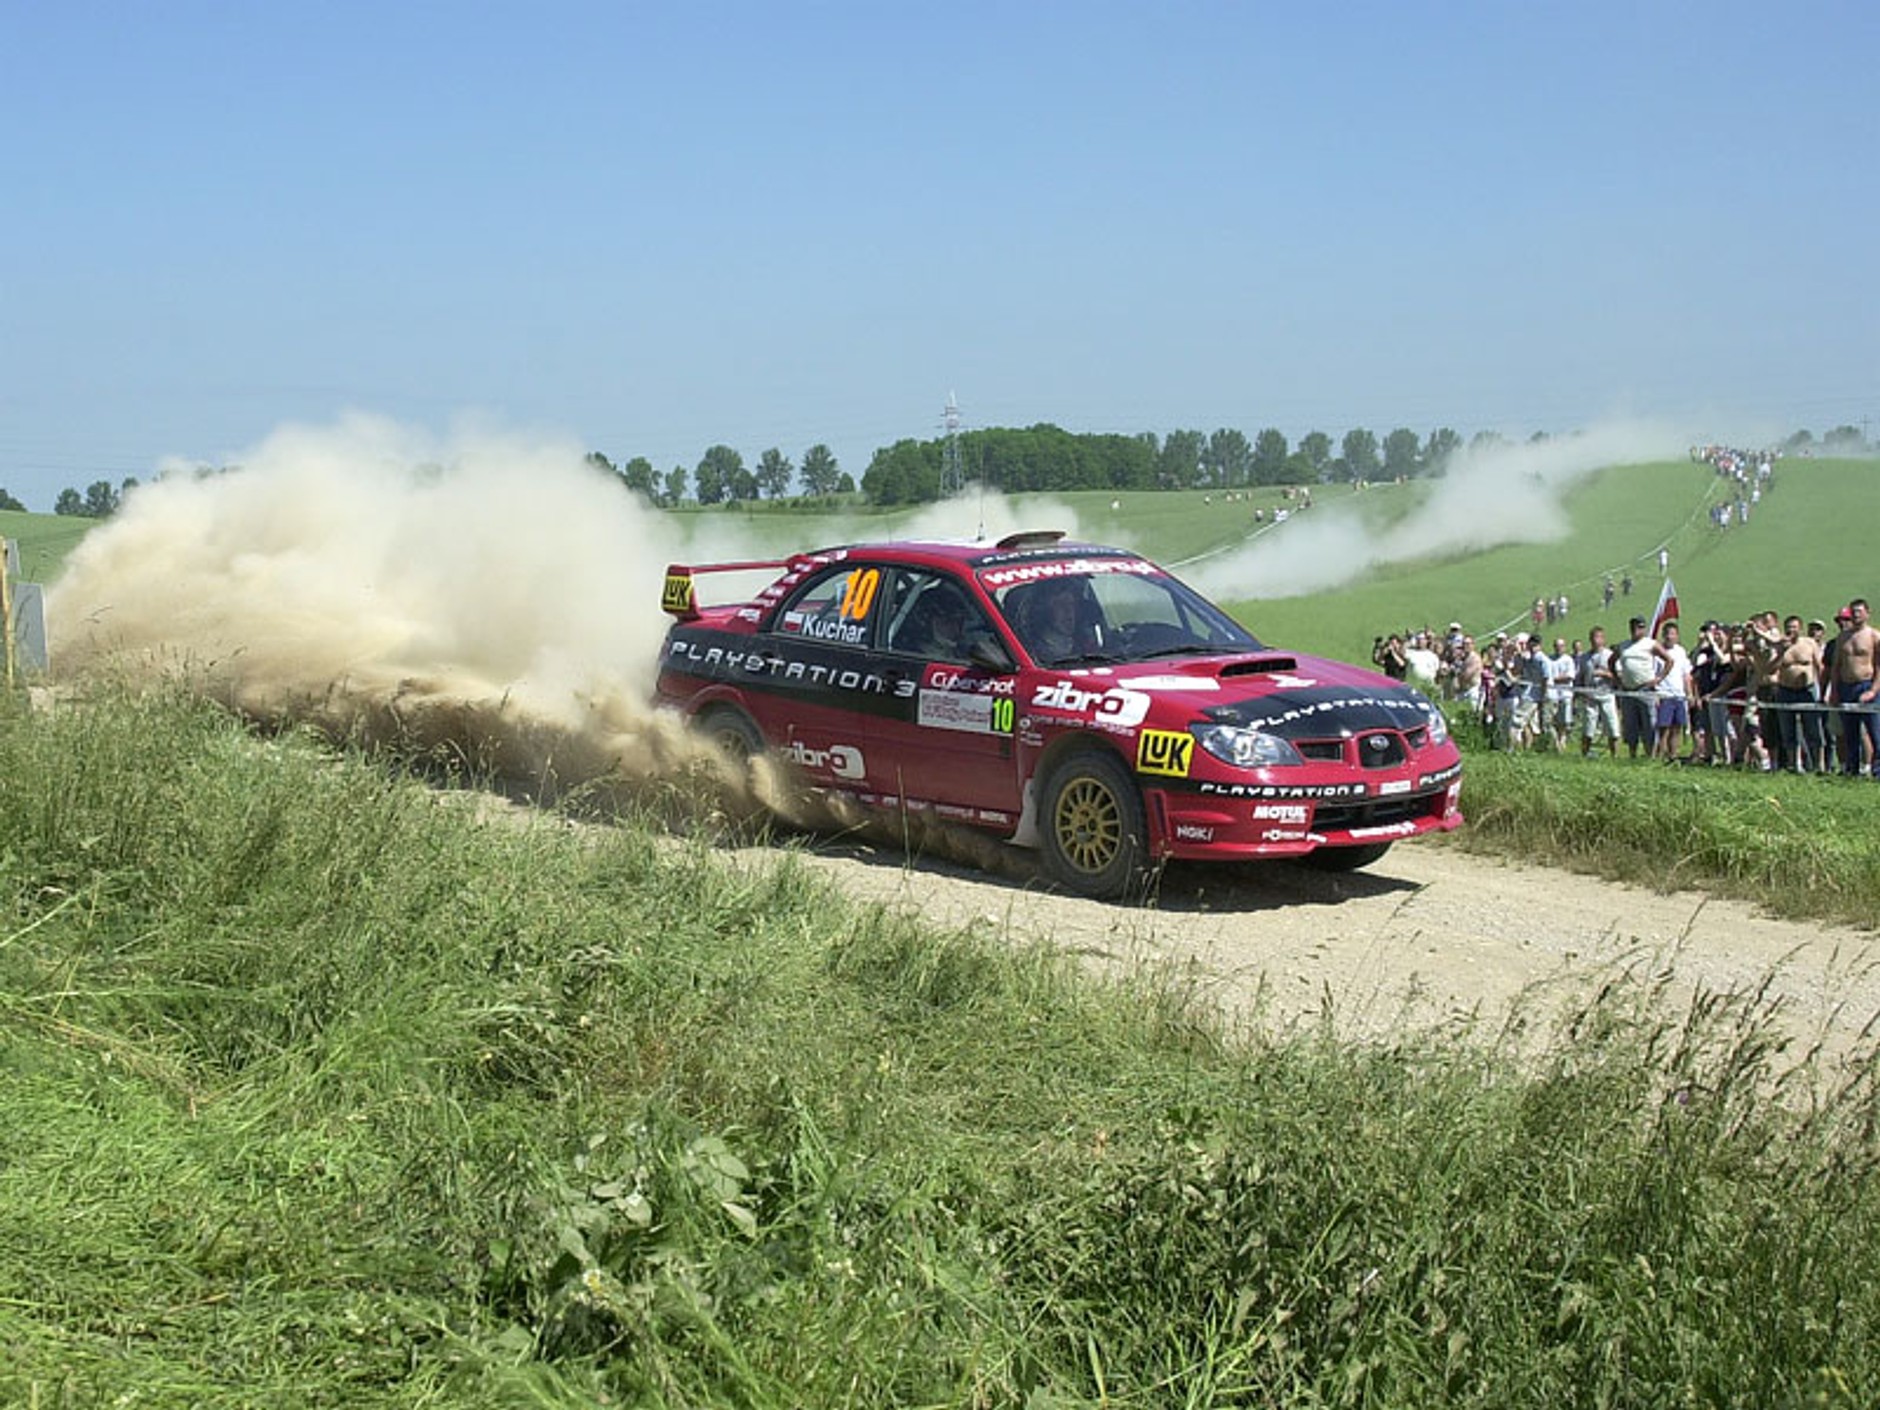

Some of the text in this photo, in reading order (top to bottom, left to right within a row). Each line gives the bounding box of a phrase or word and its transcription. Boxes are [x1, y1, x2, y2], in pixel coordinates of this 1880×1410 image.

[840, 567, 881, 621] 10
[802, 614, 867, 643] Kuchar
[669, 641, 918, 698] PLAYSTATION 3
[993, 699, 1014, 733] 10
[1031, 680, 1151, 727] zibro
[1250, 698, 1414, 731] PLAYSTATION
[1201, 784, 1349, 797] PLAYSTATION
[1253, 806, 1306, 819] MOTUL
